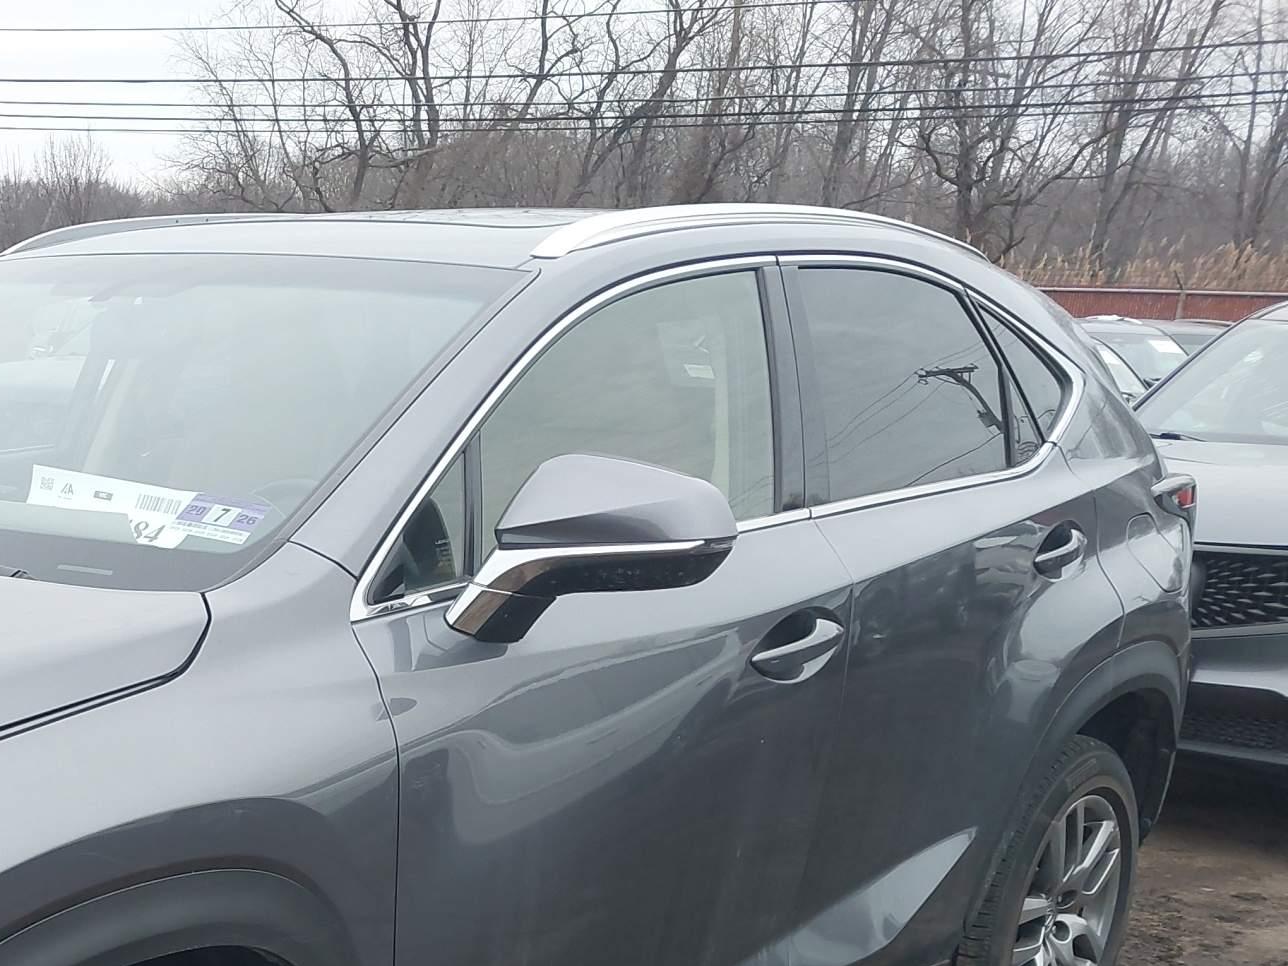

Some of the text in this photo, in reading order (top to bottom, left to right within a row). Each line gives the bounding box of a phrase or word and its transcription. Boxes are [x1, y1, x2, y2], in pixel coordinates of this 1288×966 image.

[213, 507, 232, 523] 7
[236, 514, 259, 525] 26
[129, 519, 165, 542] 84
